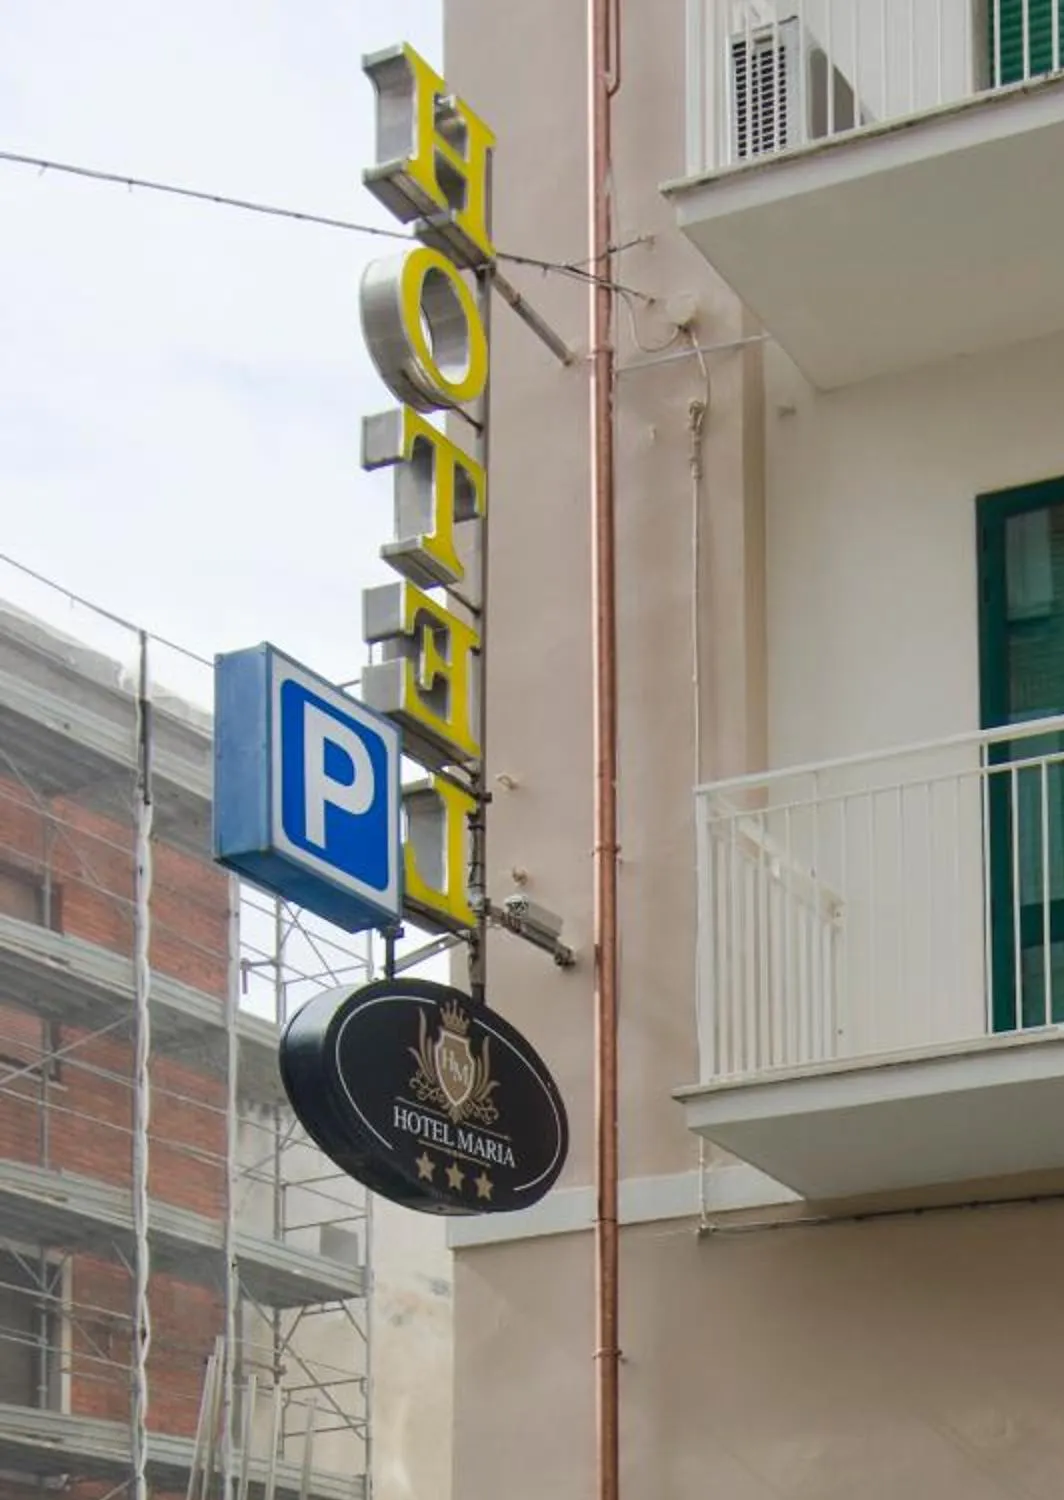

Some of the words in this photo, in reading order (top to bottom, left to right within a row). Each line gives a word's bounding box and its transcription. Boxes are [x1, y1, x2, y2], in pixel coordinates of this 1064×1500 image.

[303, 699, 375, 849] P
[393, 1105, 455, 1146] HOTEL
[457, 1129, 516, 1168] MARIA
